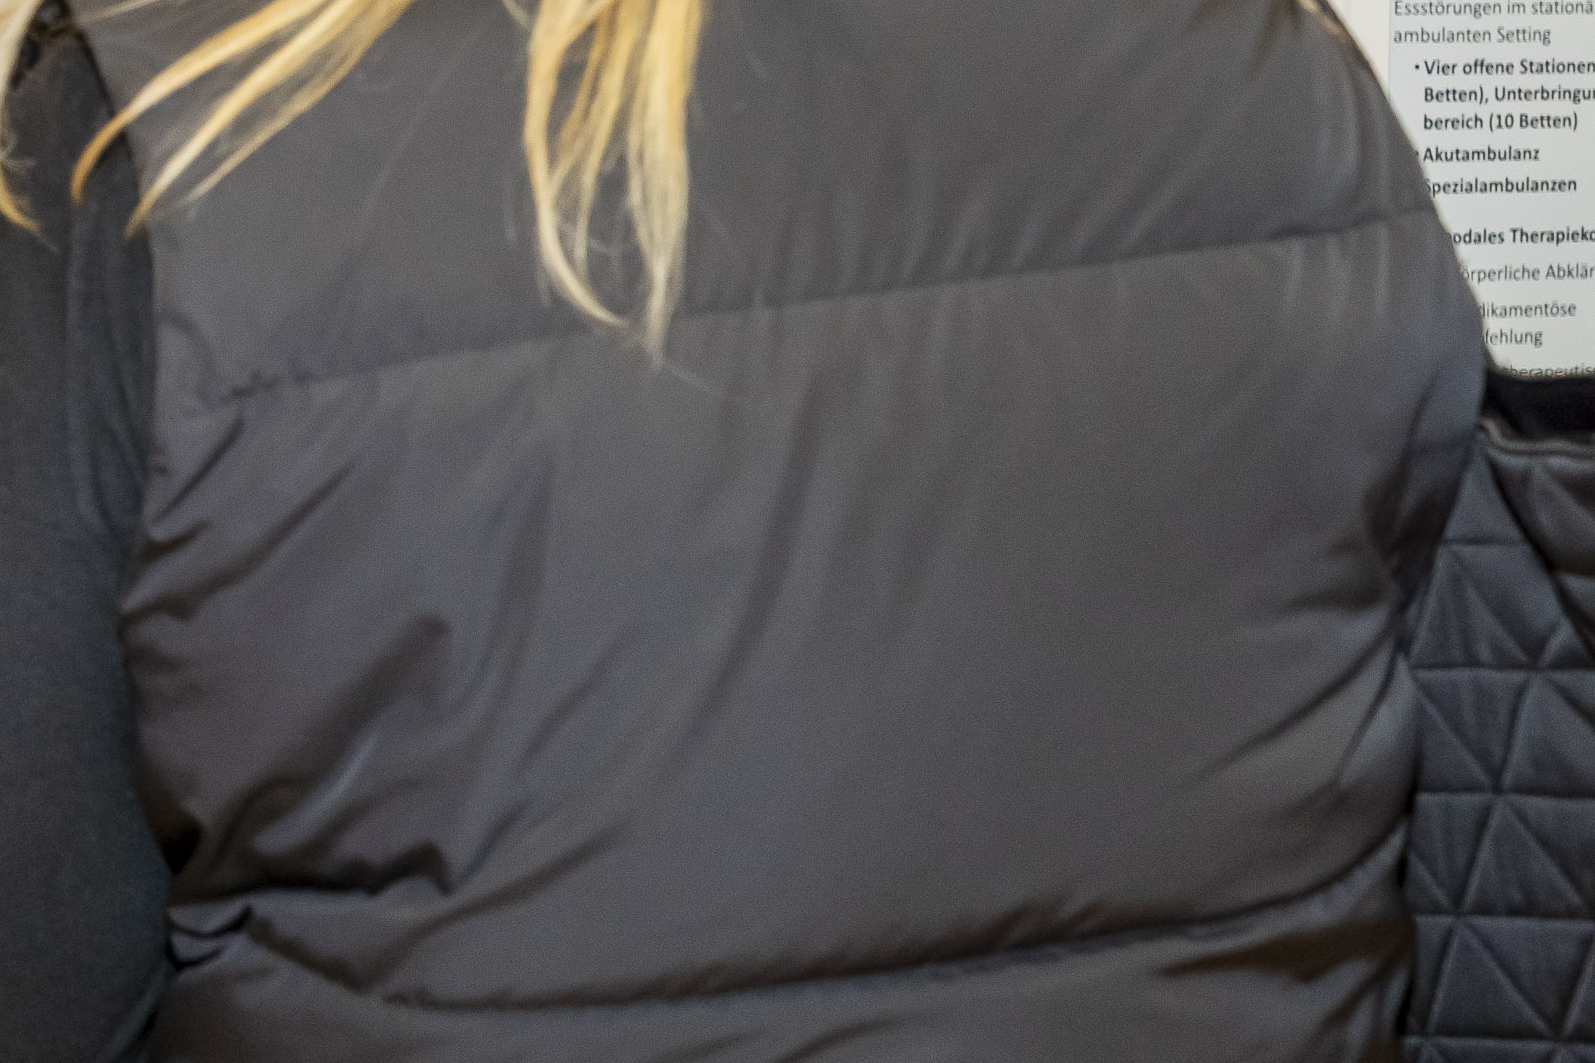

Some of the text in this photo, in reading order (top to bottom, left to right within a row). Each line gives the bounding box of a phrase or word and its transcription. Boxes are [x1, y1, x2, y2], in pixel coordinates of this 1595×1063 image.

[1393, 25, 1552, 47] ambulanten Setting
[1423, 57, 1595, 76] Vier offene Stationen
[1424, 84, 1490, 105] Betten),
[1423, 111, 1579, 134] bereich (10 Betten)
[1423, 144, 1540, 163] Akutambulanz
[1452, 227, 1505, 245] odales
[1461, 264, 1541, 285] örperliche
[1484, 328, 1544, 349] fehlung
